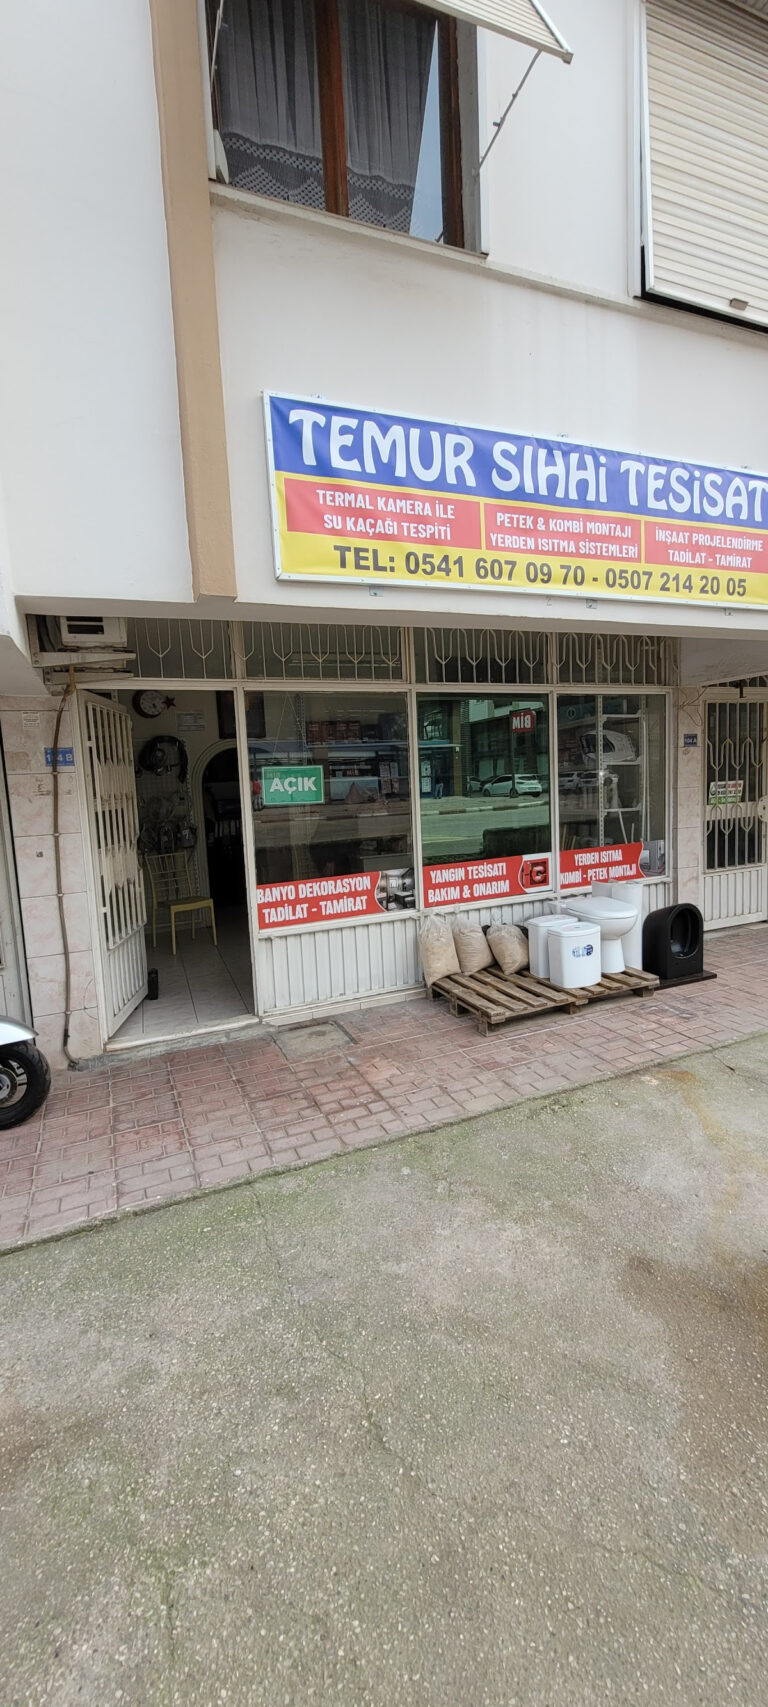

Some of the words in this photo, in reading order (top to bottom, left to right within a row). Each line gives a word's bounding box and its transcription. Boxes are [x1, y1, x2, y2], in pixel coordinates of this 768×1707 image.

[289, 409, 476, 487] TEMUR
[316, 489, 374, 510] TERMAL
[377, 496, 432, 516] KAMERA
[435, 501, 455, 519] İLE
[323, 514, 342, 529] SU
[346, 516, 398, 536] KAÇAĞI
[401, 522, 451, 541] TESPİTİ
[496, 512, 534, 530] PETEK
[537, 516, 546, 531] &
[549, 518, 583, 534] KOMBİ
[586, 523, 632, 539] MONTAJI
[490, 532, 535, 550] YERDEN
[538, 537, 576, 554] ISITMA
[579, 539, 638, 559] SİSTEMLERİ
[655, 526, 690, 545] İNŞAAT
[692, 533, 763, 552] PROJELENDİRME
[333, 545, 396, 573] TEL:
[405, 551, 464, 578] 0541
[475, 557, 517, 581] 607
[525, 561, 552, 584] 09
[559, 564, 586, 586] 70
[605, 567, 653, 591] 0507
[659, 571, 693, 594] 214
[699, 575, 720, 596] 20
[726, 577, 747, 597] 05
[668, 549, 706, 565] TADİLAT
[715, 554, 752, 569] TAMİRAT
[65, 754, 73, 762] B
[270, 777, 317, 795] AÇIK
[574, 851, 599, 866] YERDEN
[600, 849, 622, 863] ISITMA
[430, 866, 465, 883] YANGIN
[467, 862, 507, 880] TESİSATI
[560, 868, 582, 885] KOMBİ
[587, 867, 608, 881] PETEK
[609, 863, 637, 878] MONTAJI
[257, 885, 296, 904] BANYO
[298, 876, 371, 899] DEKORASYON
[427, 885, 460, 903] BAKIM
[462, 884, 471, 899] &
[473, 879, 510, 895] ONARIM
[263, 903, 308, 923] TADİLAT
[320, 895, 367, 916] TAMİRAT
